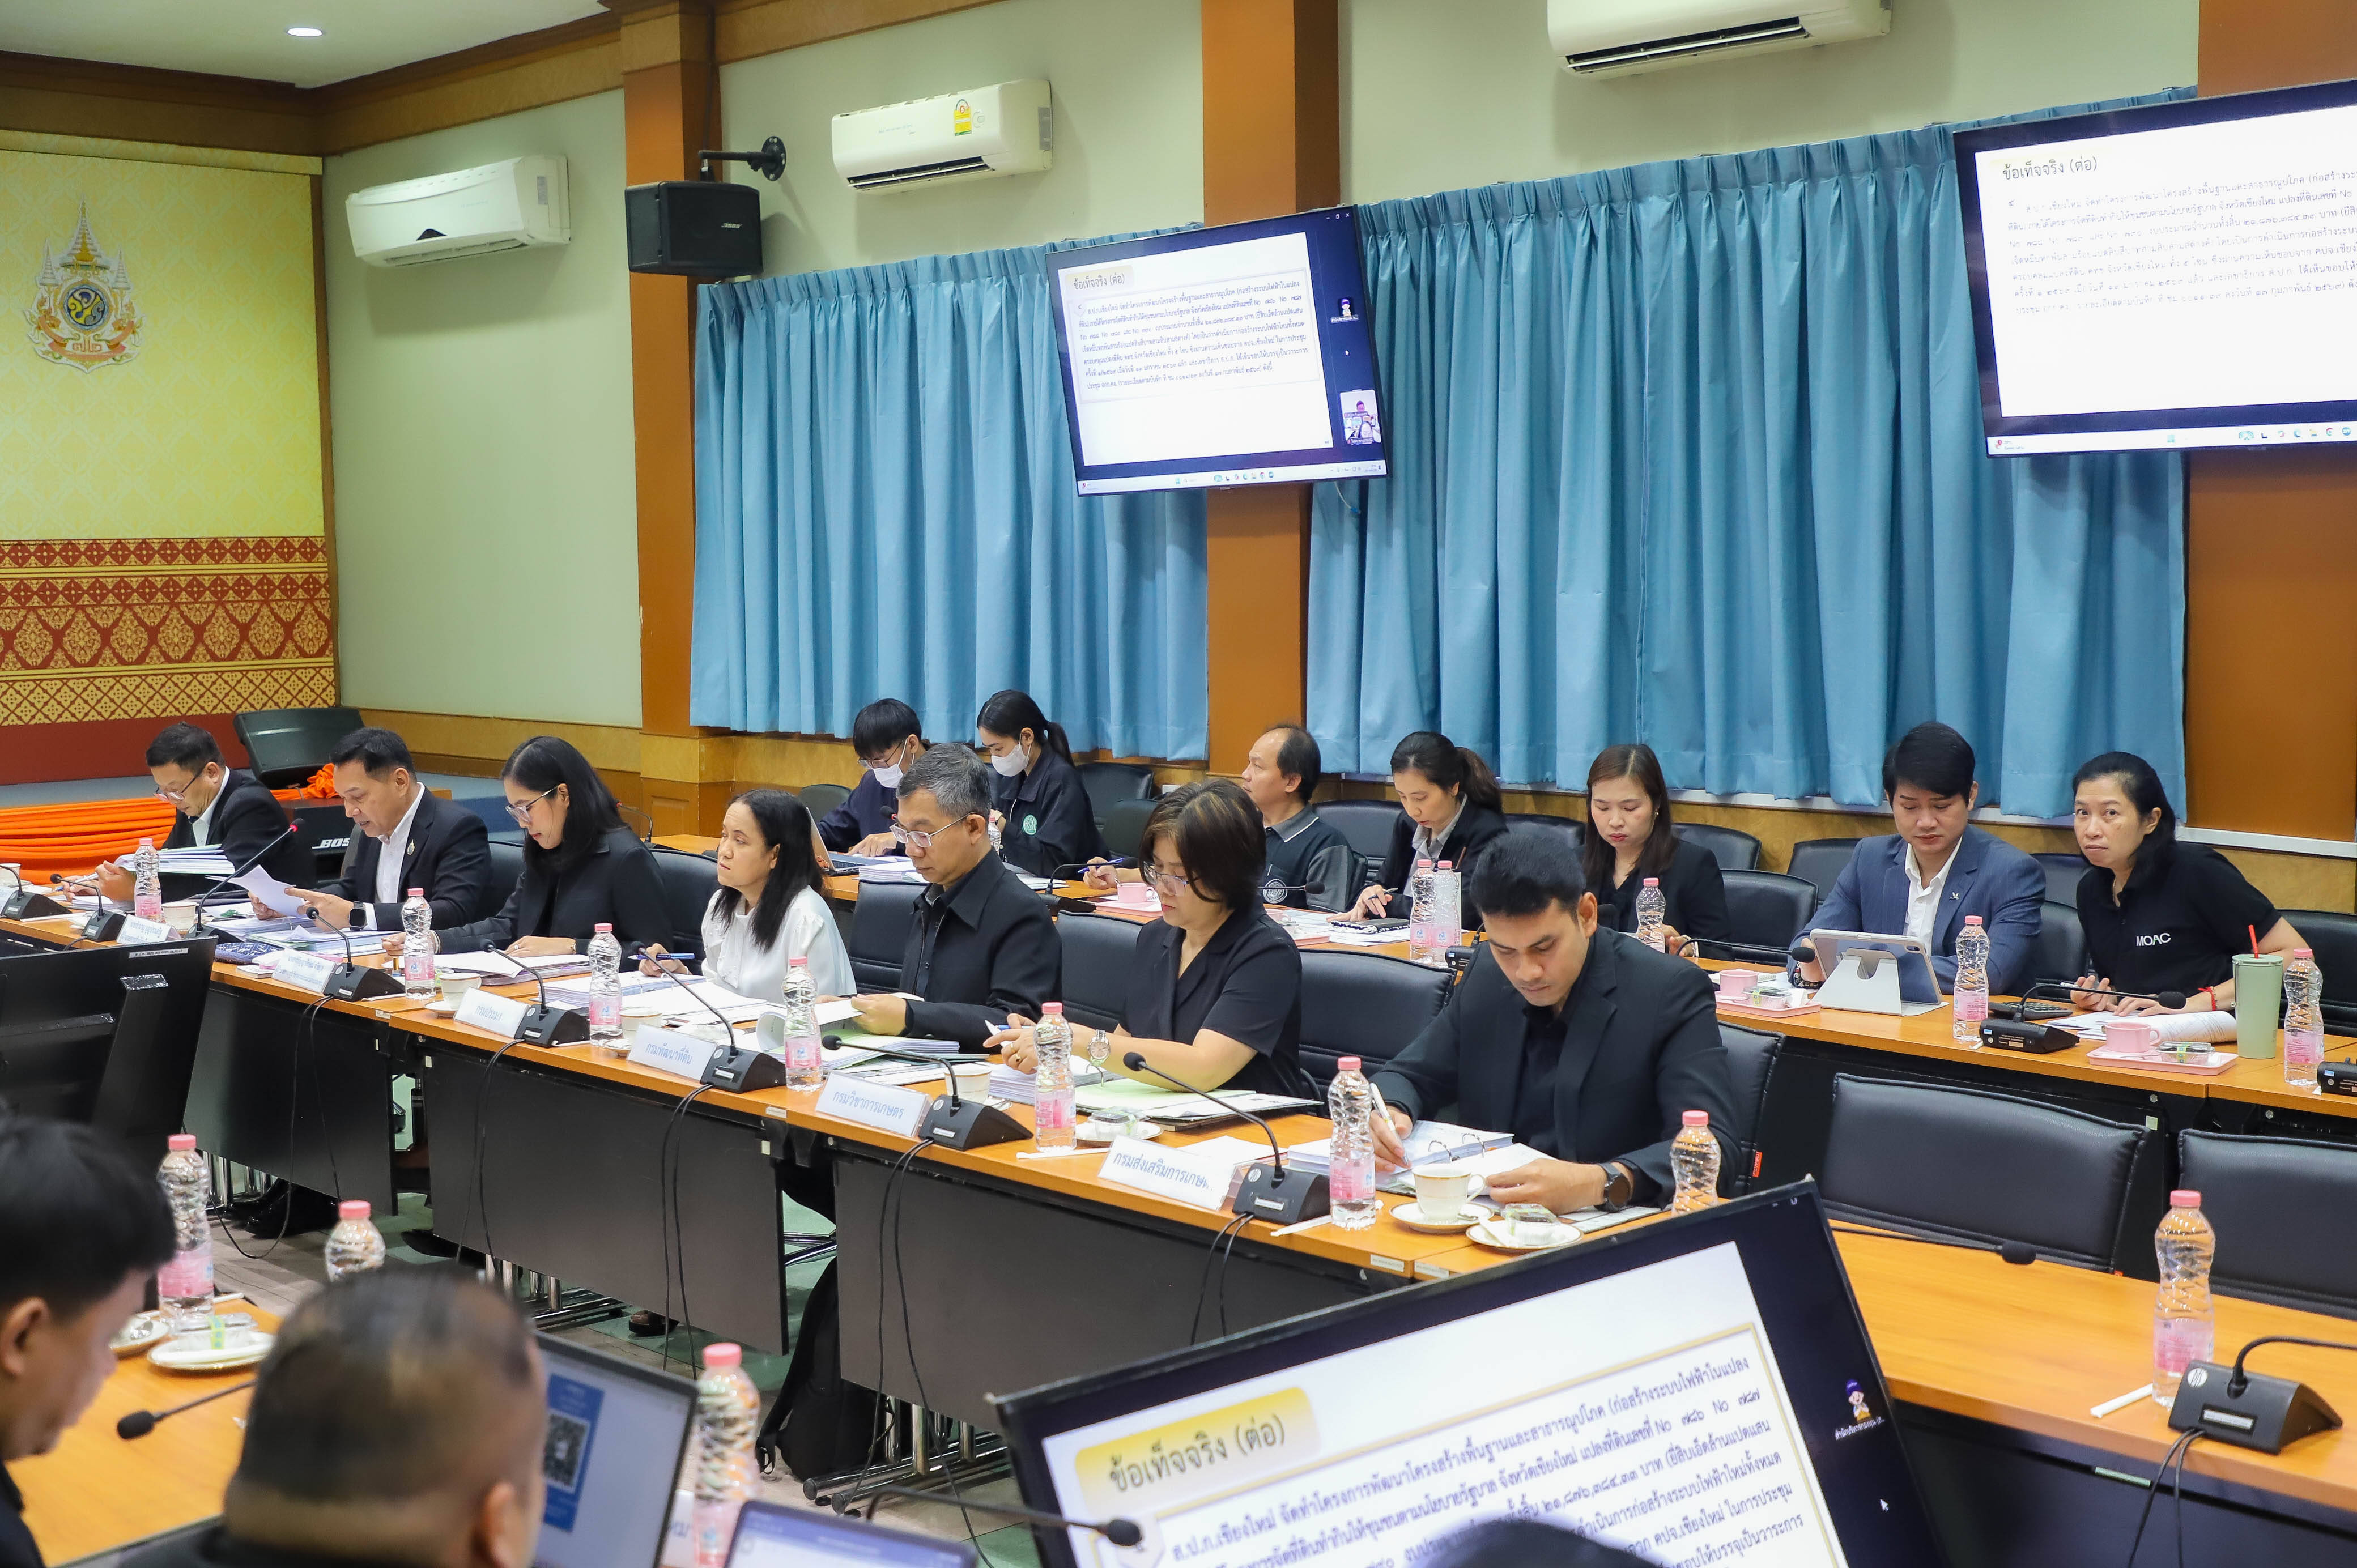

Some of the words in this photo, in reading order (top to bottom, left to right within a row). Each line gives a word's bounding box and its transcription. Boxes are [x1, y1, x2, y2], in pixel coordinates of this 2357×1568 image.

[2002, 159, 2064, 180] ข้อเท็จจริง
[2069, 155, 2097, 173] (ต่อ)
[2339, 189, 2352, 198] No
[2318, 210, 2337, 218] บาท
[1073, 274, 1107, 290] ข้อเท็จจริง
[1109, 272, 1125, 286] (ต่อ)
[312, 837, 351, 849] BOS
[2136, 932, 2171, 947] MOAC
[645, 1042, 694, 1064] กรมพัฒนาที่ดิน
[832, 1090, 905, 1119] กรมวิชาการเกษตร
[1113, 1152, 1212, 1191] กรมส่งเสริมการเกษ
[1609, 1358, 1748, 1409] (ก่อสร้างระบบไฟฟ้าในแปลง
[1109, 1433, 1227, 1490] ข้อเท็จจริง
[1235, 1414, 1284, 1454] (ต่อ)
[1499, 1450, 1577, 1487] จังหวัดเชียงใหม่
[1582, 1419, 1650, 1459] แปลงที่ดินเลขที่
[1654, 1420, 1671, 1432] No
[1712, 1399, 1729, 1413] No
[1639, 1458, 1662, 1476] บาท
[1666, 1421, 1770, 1464] (ยี่สิบเอ็ดล้านแปดแสน
[1576, 1451, 1781, 1537] ดำเนินการก่อสร้างระบบไฟฟ้าใหม่ทั้งหมด
[1654, 1509, 1725, 1543] คปจ.เชียงใหม่
[1724, 1484, 1792, 1516] ในการประชุม
[1671, 1514, 1803, 1568] ชอบให้บรรจุเป็นวาระการ
